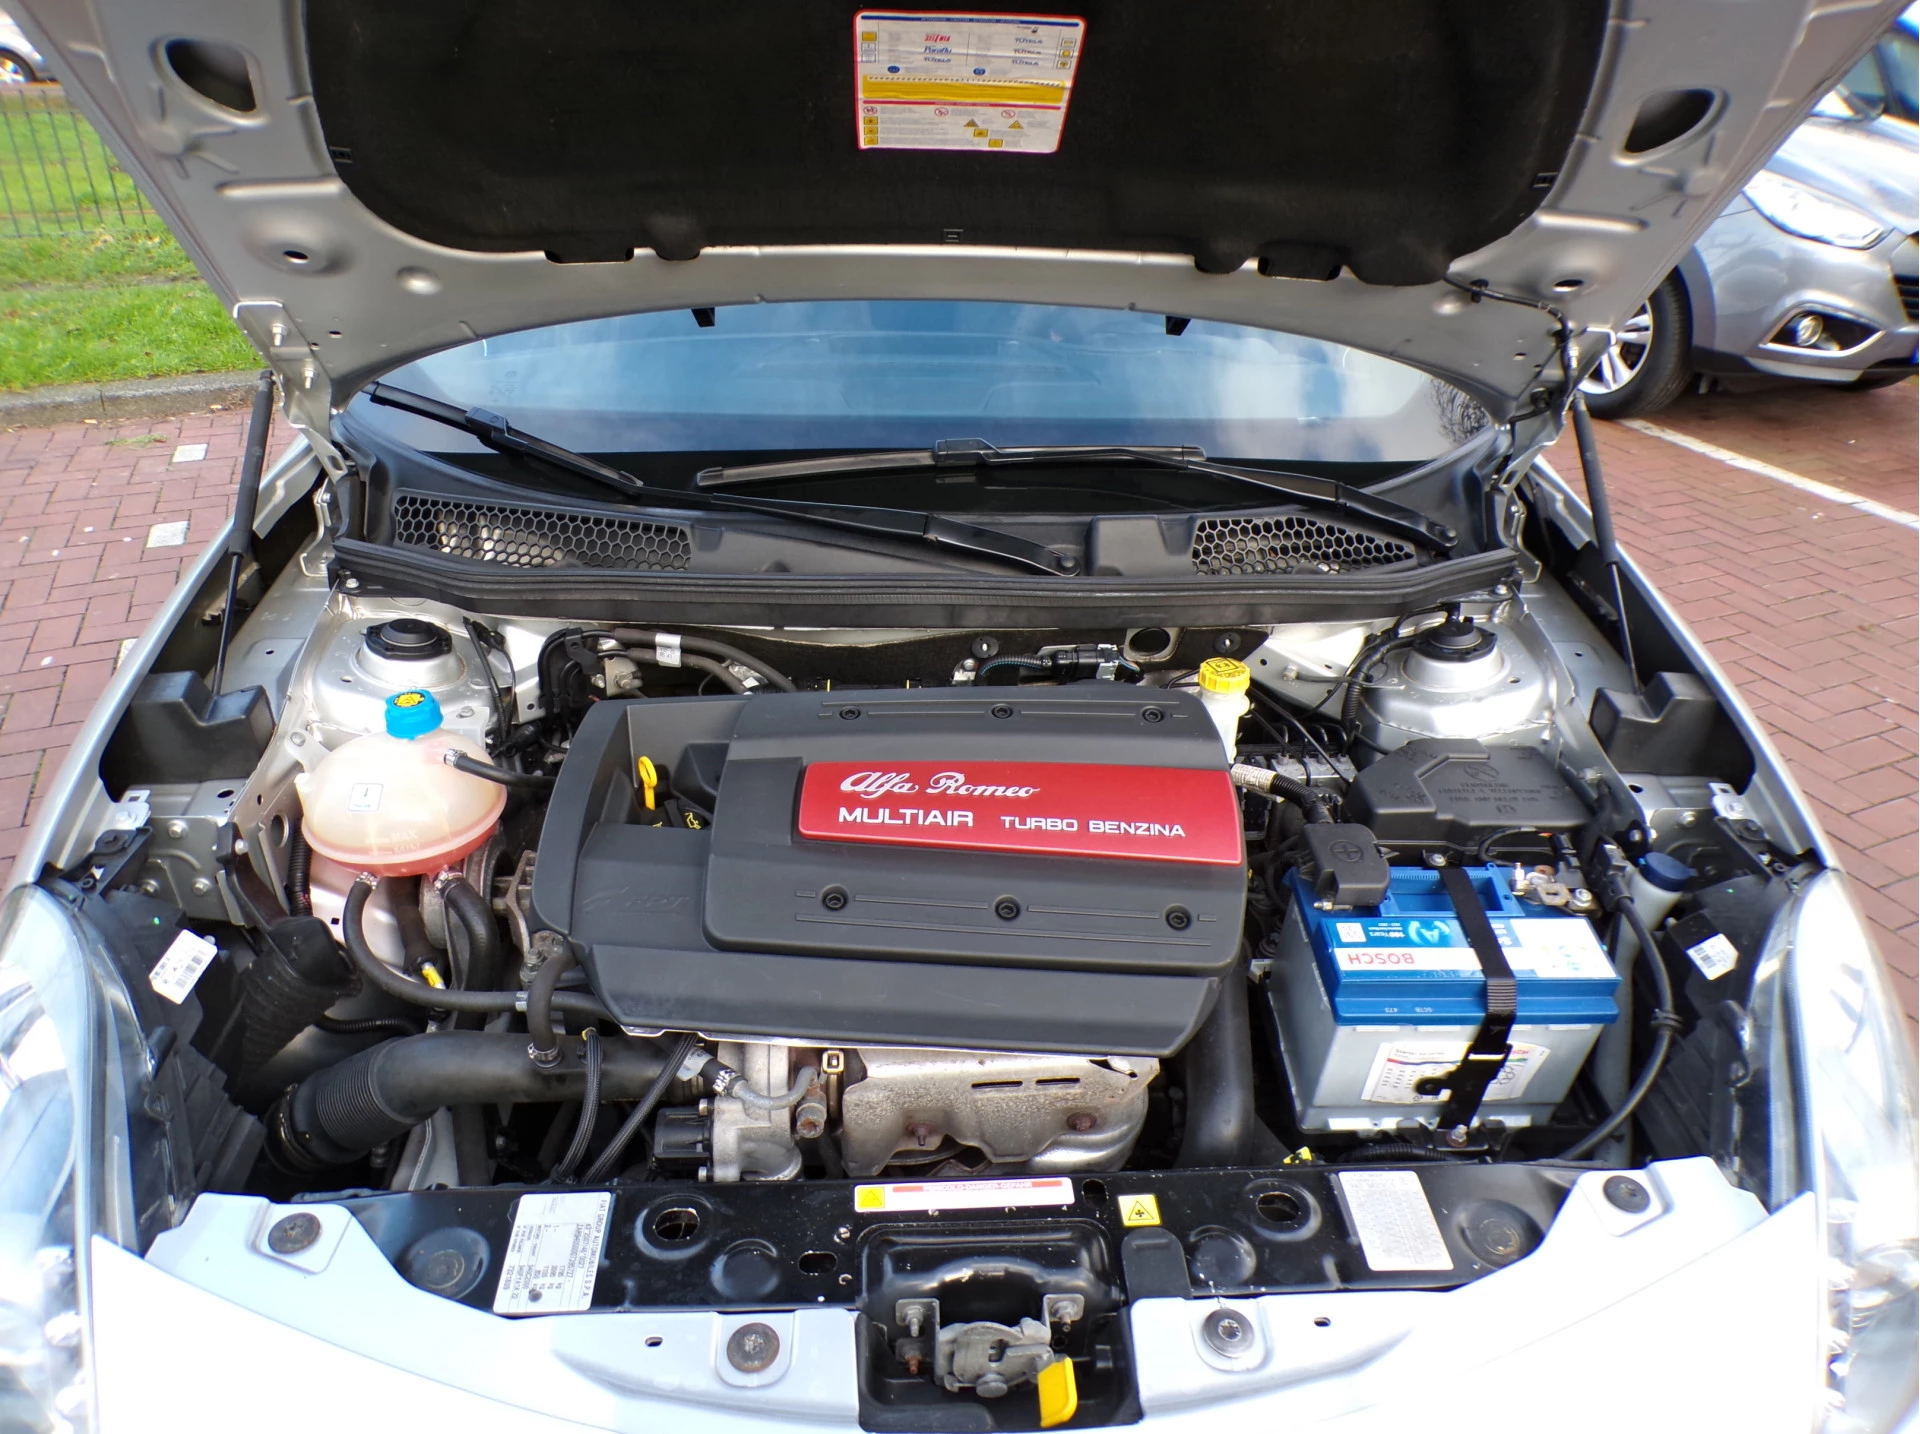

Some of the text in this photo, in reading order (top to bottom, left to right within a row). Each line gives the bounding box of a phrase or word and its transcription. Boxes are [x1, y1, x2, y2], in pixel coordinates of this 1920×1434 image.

[840, 771, 1040, 798] Alfa Romeo
[838, 807, 1186, 838] MULTIAIR TURBO BENZINA
[1347, 953, 1416, 965] BOSCH
[598, 1199, 607, 1211] FIAT
[593, 1213, 604, 1233] GROUP
[585, 1235, 600, 1278] AUTOMOBILES
